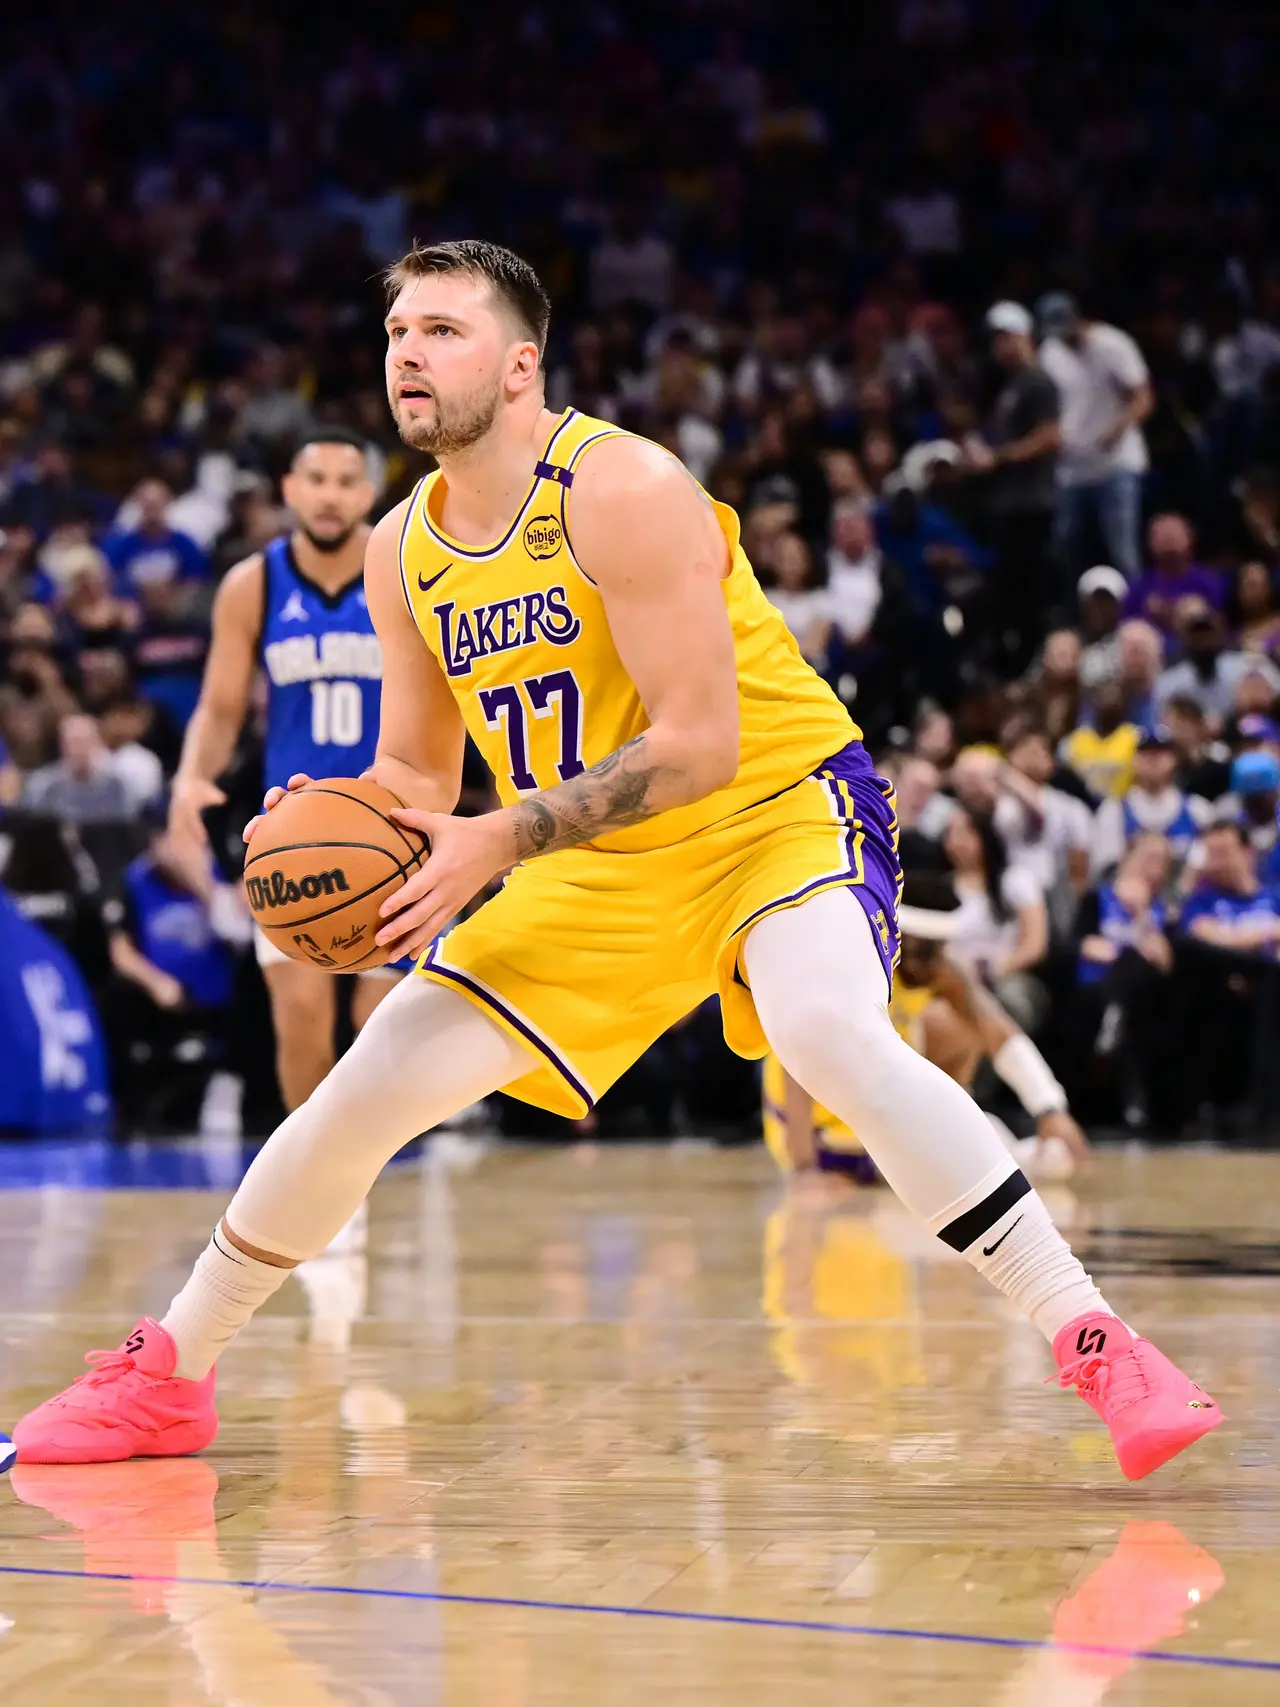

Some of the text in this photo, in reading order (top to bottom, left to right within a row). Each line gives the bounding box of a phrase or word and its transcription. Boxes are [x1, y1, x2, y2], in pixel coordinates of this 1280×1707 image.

[527, 528, 560, 545] bibigo
[433, 586, 581, 677] LAKERS
[310, 679, 363, 746] 10
[478, 669, 586, 796] 77
[246, 867, 350, 911] Wilson
